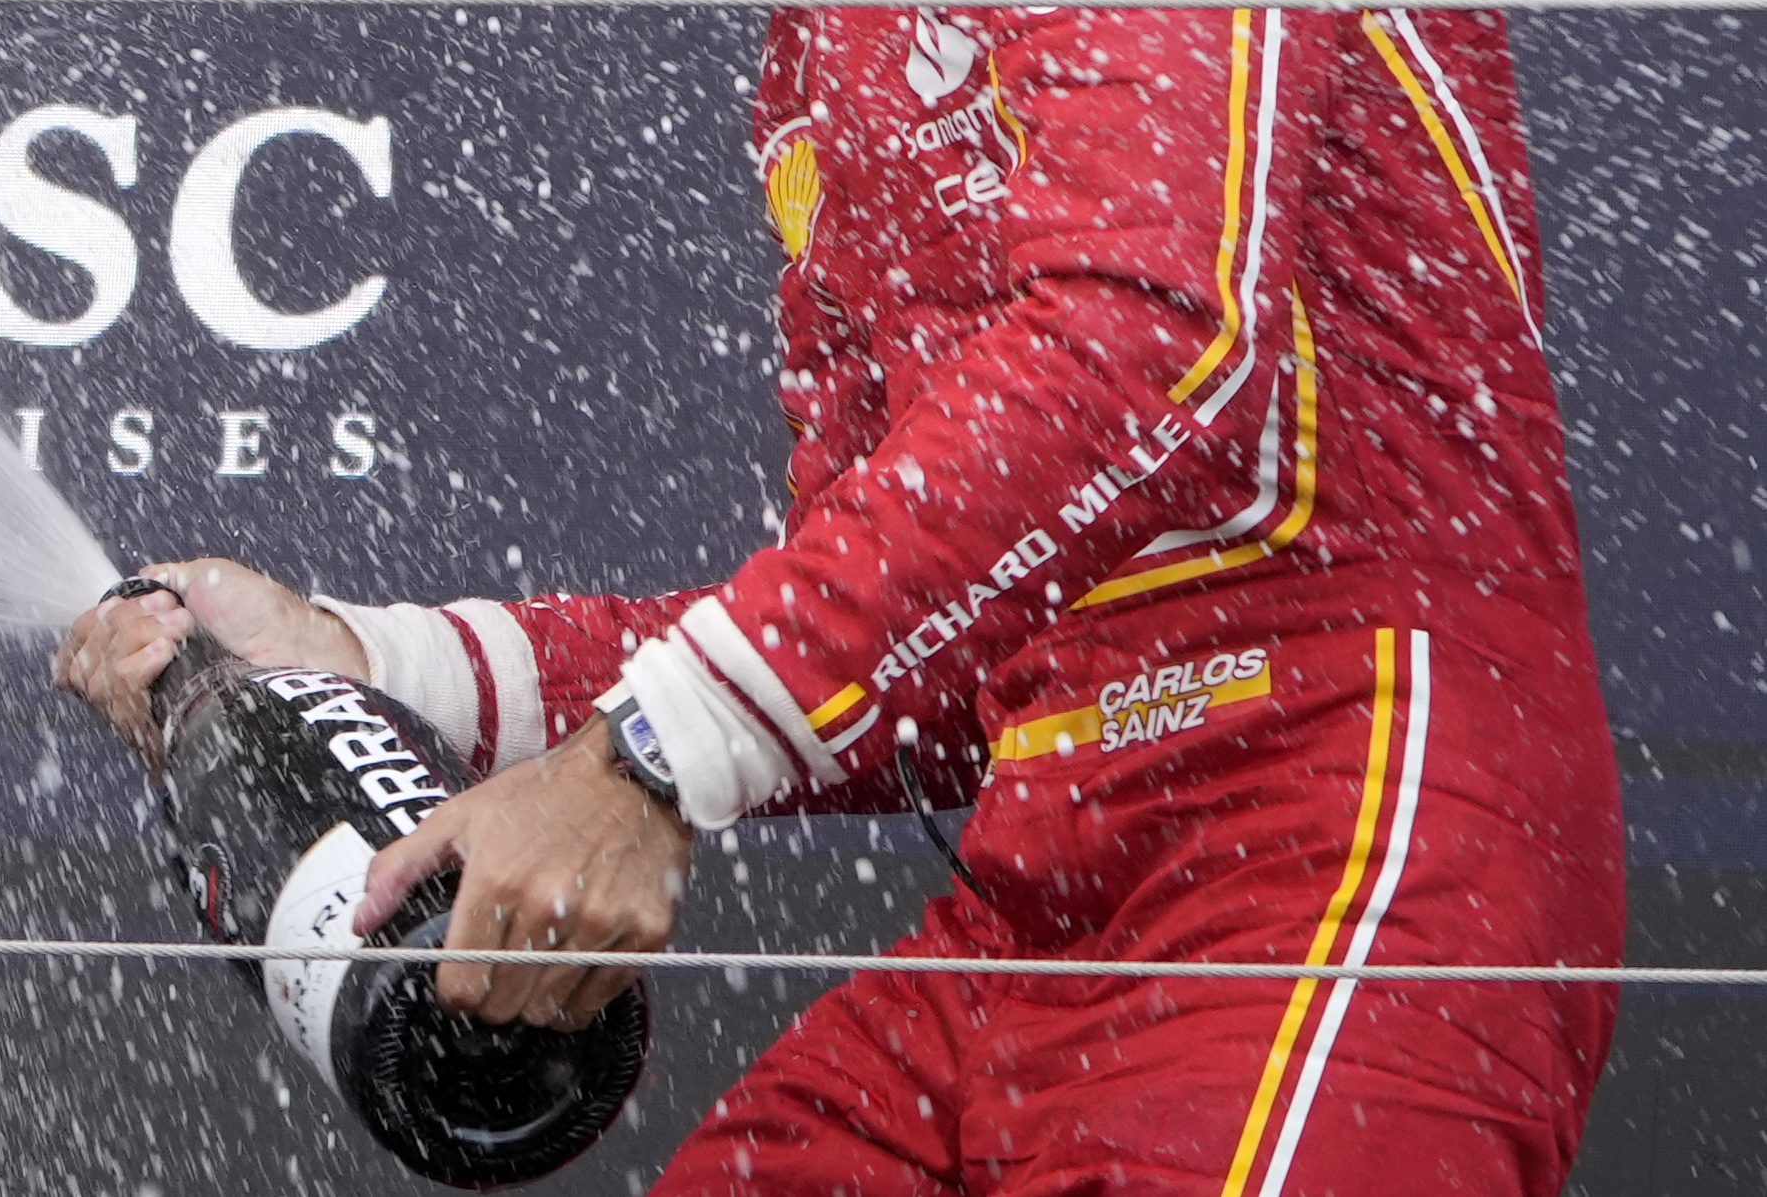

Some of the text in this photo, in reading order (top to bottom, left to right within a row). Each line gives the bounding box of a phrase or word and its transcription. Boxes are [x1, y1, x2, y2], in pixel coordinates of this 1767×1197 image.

[870, 412, 1192, 693] RICHARD MILLE
[1099, 647, 1267, 717] CARLOS
[1100, 694, 1212, 753] SAINZ
